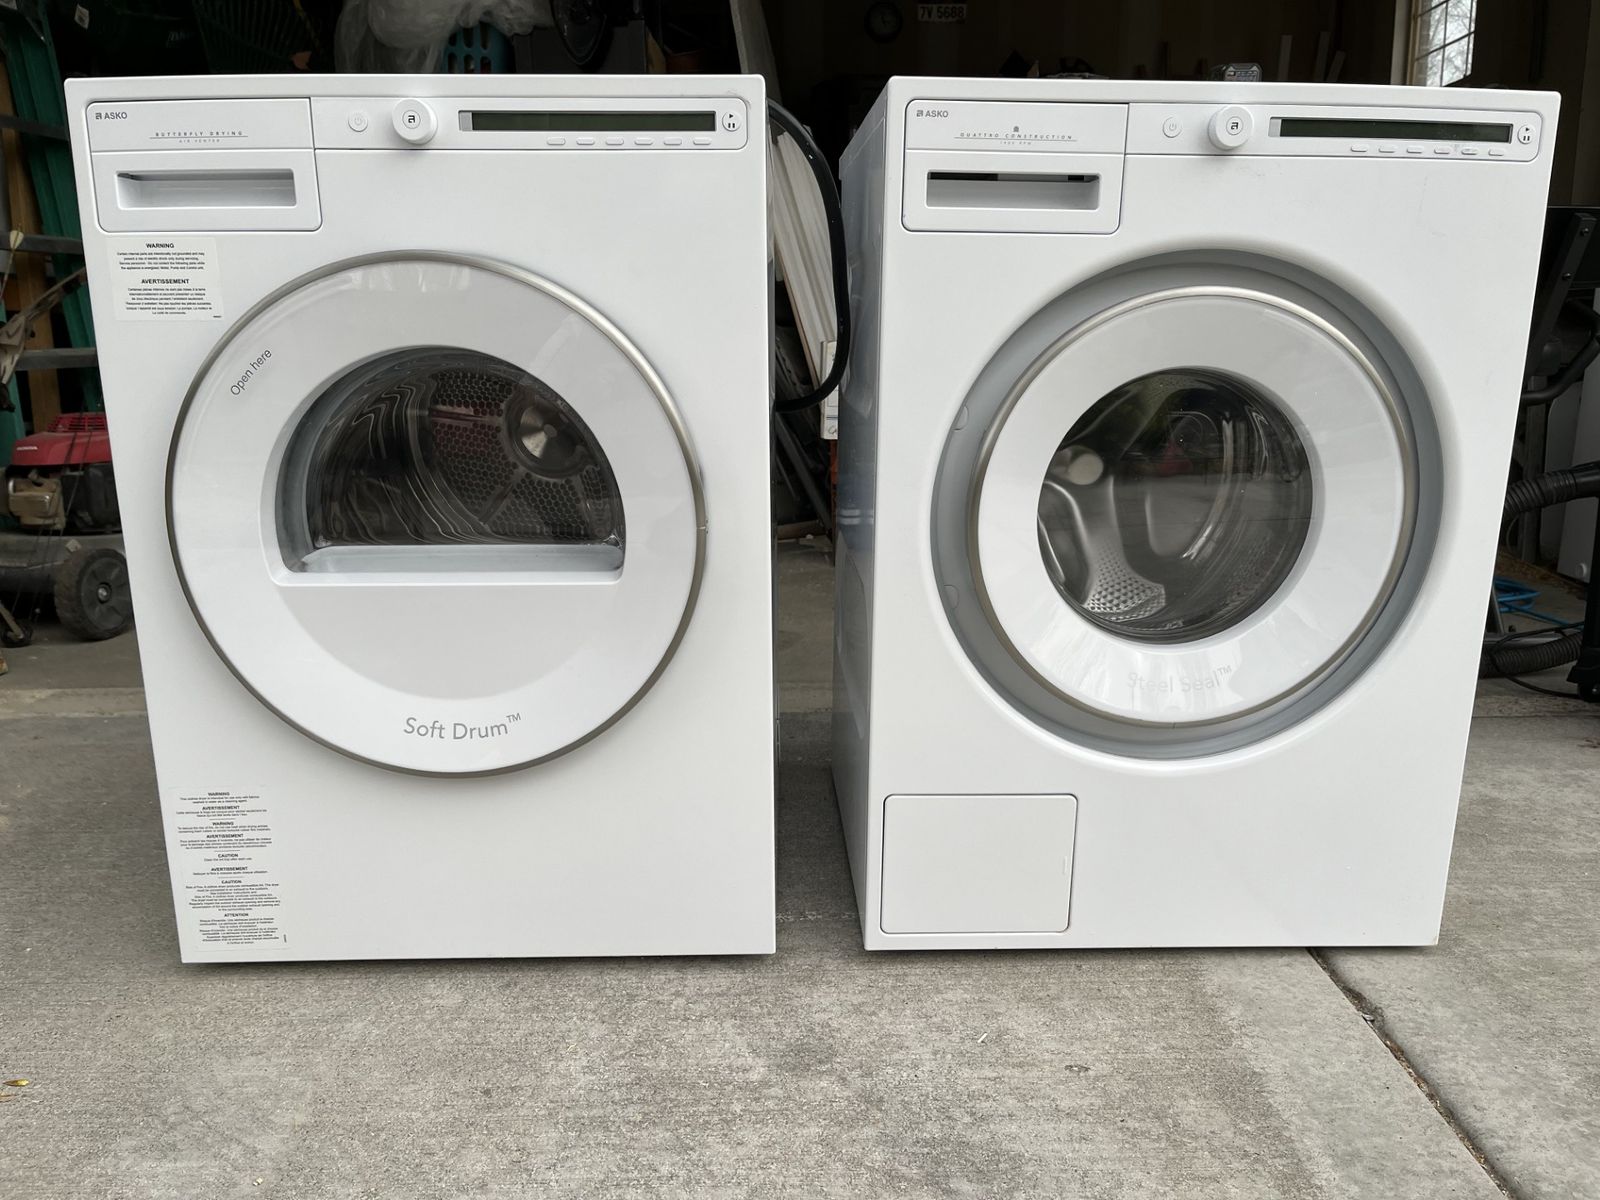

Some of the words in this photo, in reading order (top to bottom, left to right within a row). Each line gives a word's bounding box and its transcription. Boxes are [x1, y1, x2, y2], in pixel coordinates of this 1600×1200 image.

[104, 112, 128, 120] ASKO
[925, 110, 948, 118] ASKO
[230, 369, 254, 396] Open
[249, 350, 272, 370] here
[1127, 672, 1173, 693] Steel
[404, 716, 445, 739] Soft
[453, 712, 522, 740] Drum™
